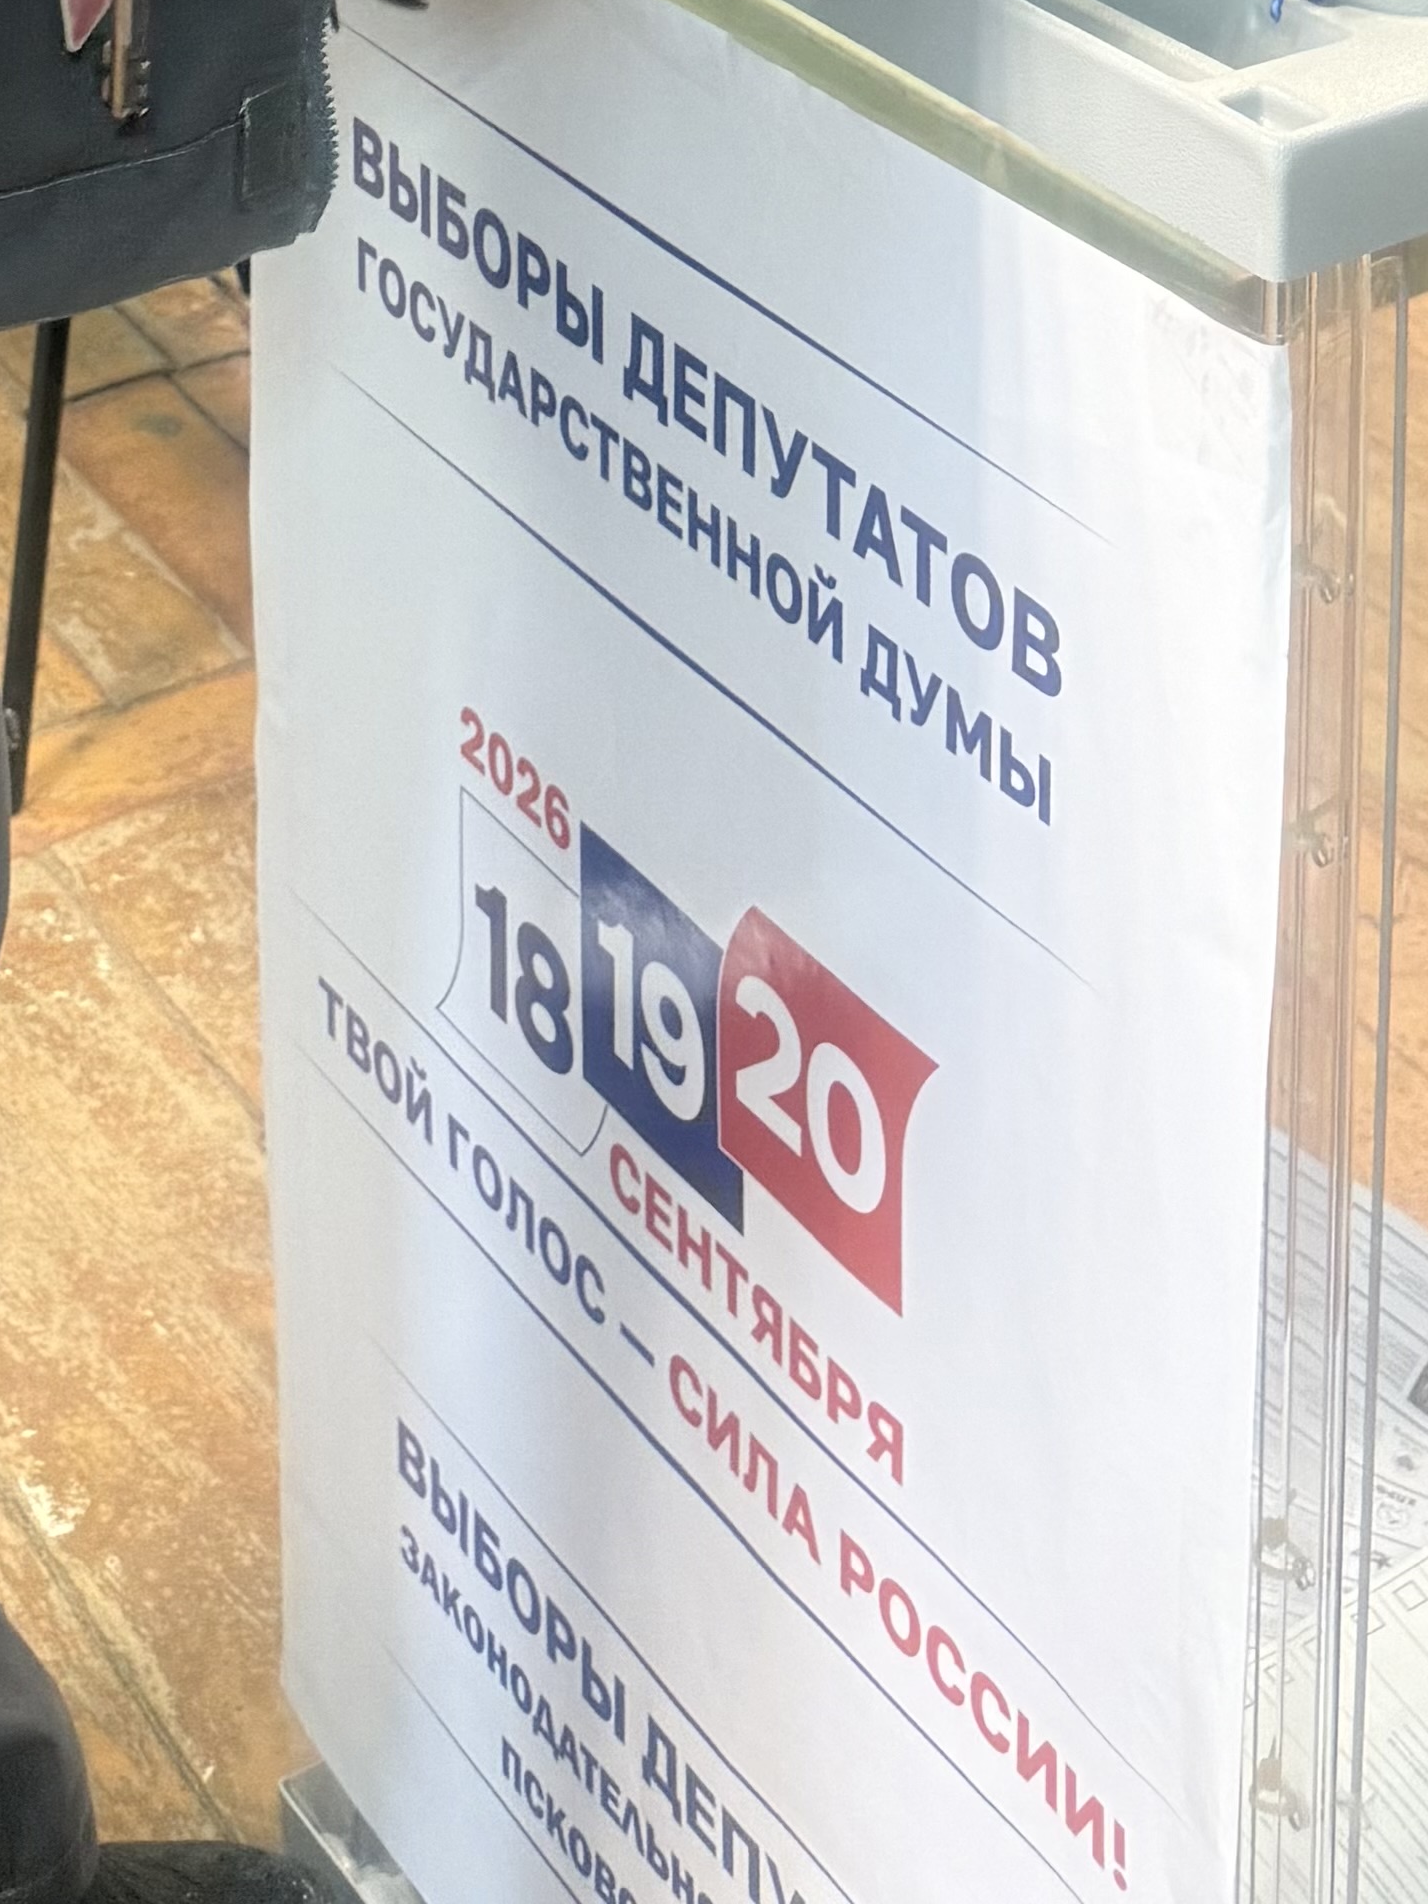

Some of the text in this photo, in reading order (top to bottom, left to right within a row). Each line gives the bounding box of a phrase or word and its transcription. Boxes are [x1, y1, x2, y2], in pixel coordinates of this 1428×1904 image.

[353, 117, 603, 362] ВЫБОРЫ
[624, 313, 1062, 698] ДЕПУТАТОВ
[358, 237, 843, 664] ГОСУДАРСТВЕННОЙ
[861, 623, 1052, 825] ДУМЫ
[460, 707, 571, 851] 2026
[476, 886, 886, 1214] 18 19 20
[319, 977, 433, 1144] ТВОЙ
[449, 1114, 606, 1324] ГОЛОС
[669, 1355, 821, 1564] СИЛА
[840, 1530, 1127, 1890] РОССИИ!
[610, 1145, 903, 1485] СЕНТЯБРЯ
[397, 1419, 626, 1742] ВЫБОРЫ
